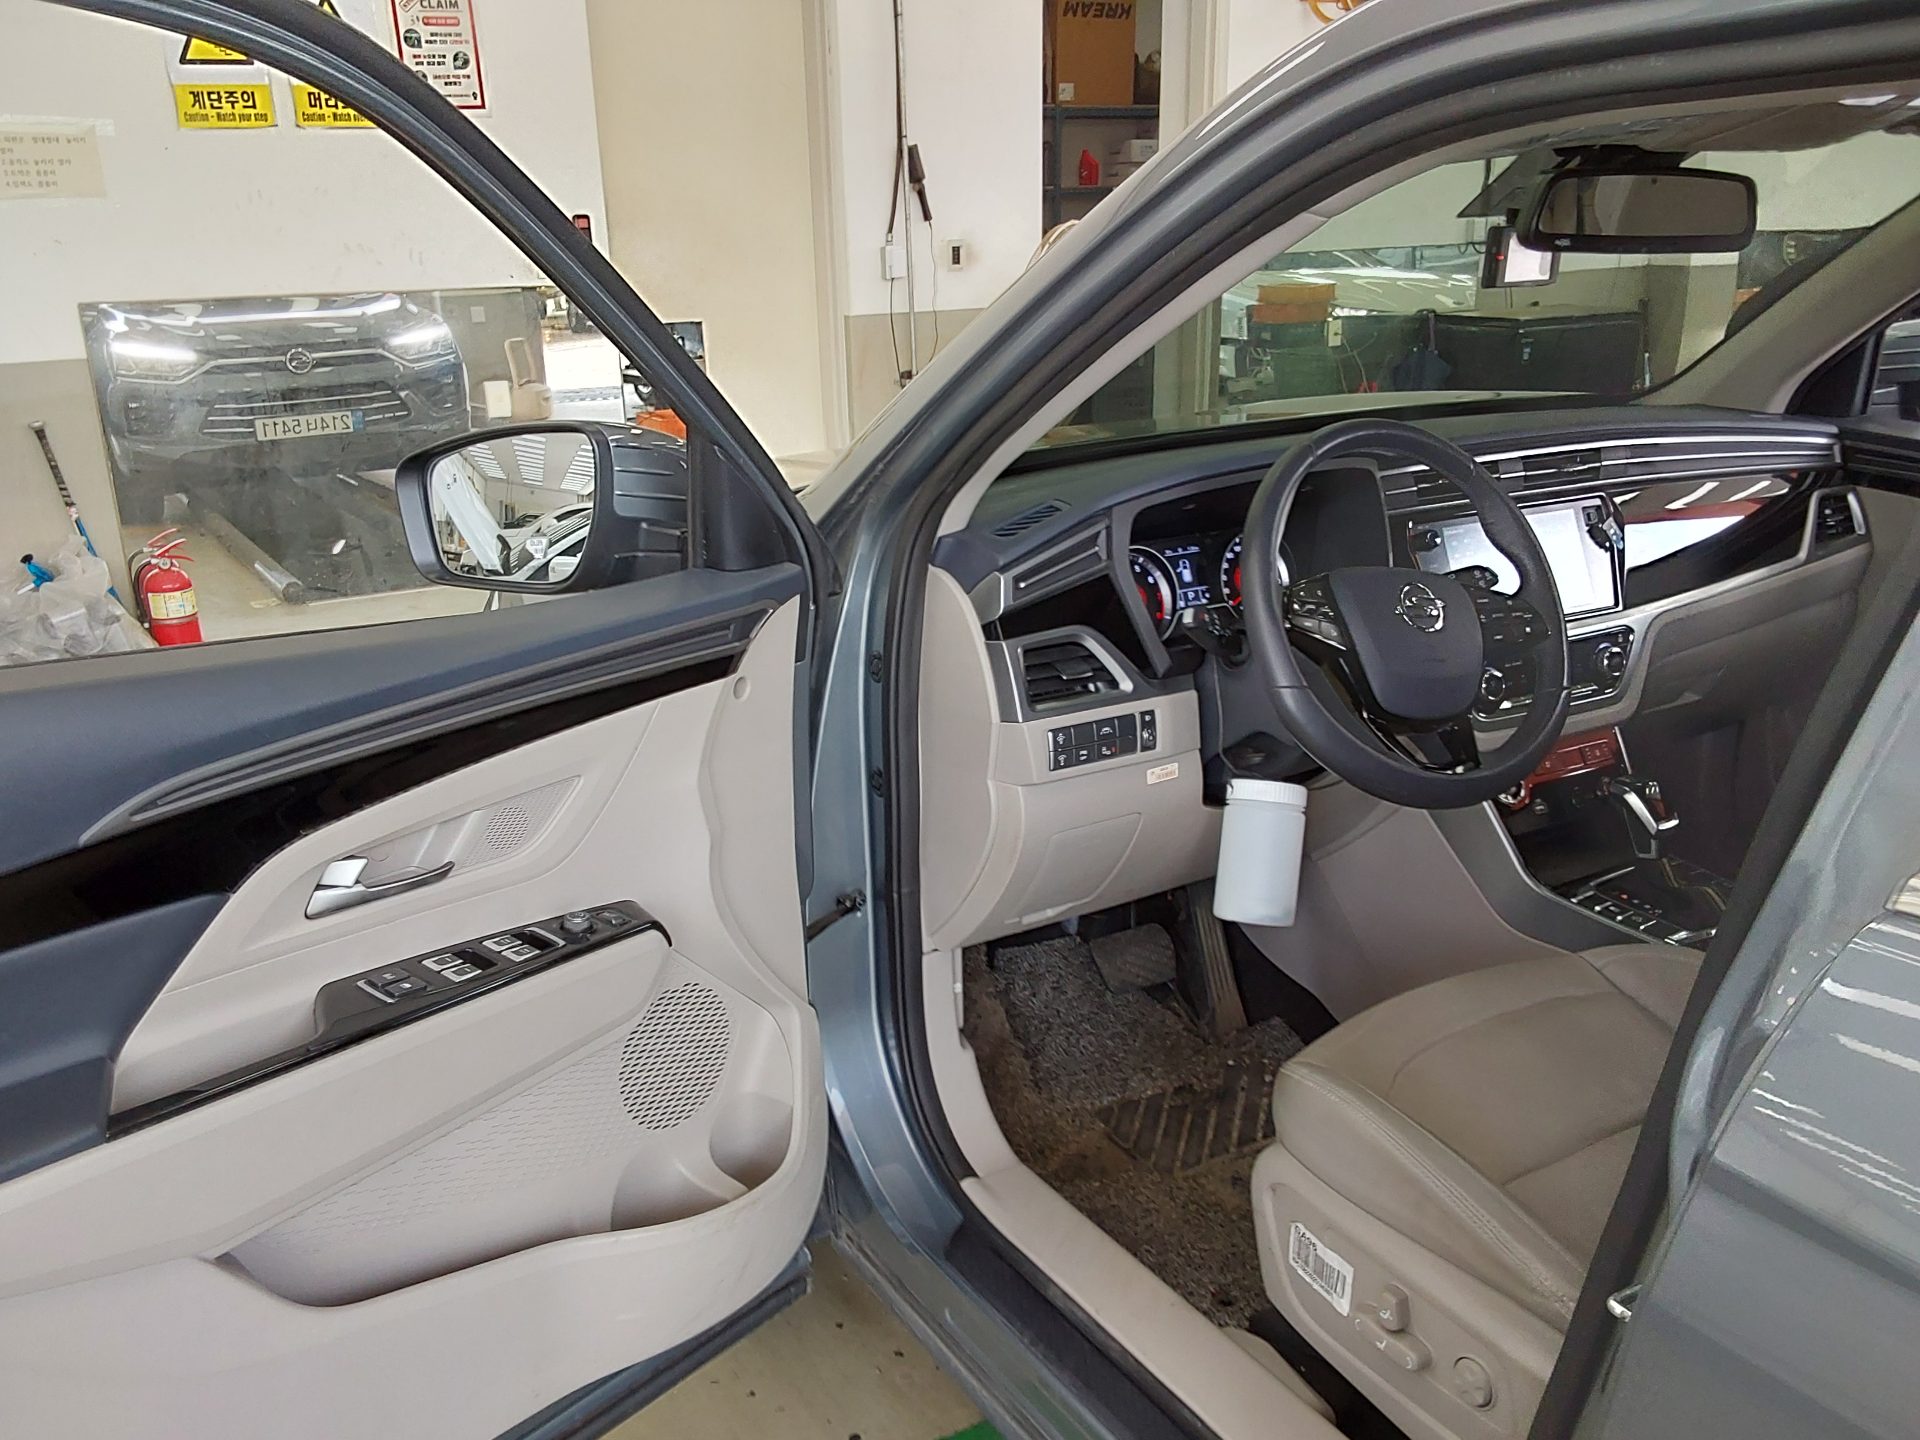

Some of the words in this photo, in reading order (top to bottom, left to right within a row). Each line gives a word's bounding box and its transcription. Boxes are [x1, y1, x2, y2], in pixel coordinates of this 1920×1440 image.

[420, 0, 459, 9] CLAIM
[1062, 1, 1132, 19] KREAM
[188, 90, 258, 110] 계단주의
[183, 111, 210, 122] Caution
[216, 111, 237, 122] Watch
[238, 112, 253, 124] your
[253, 112, 268, 122] step
[301, 111, 326, 122] Caution
[332, 111, 352, 122] Watch
